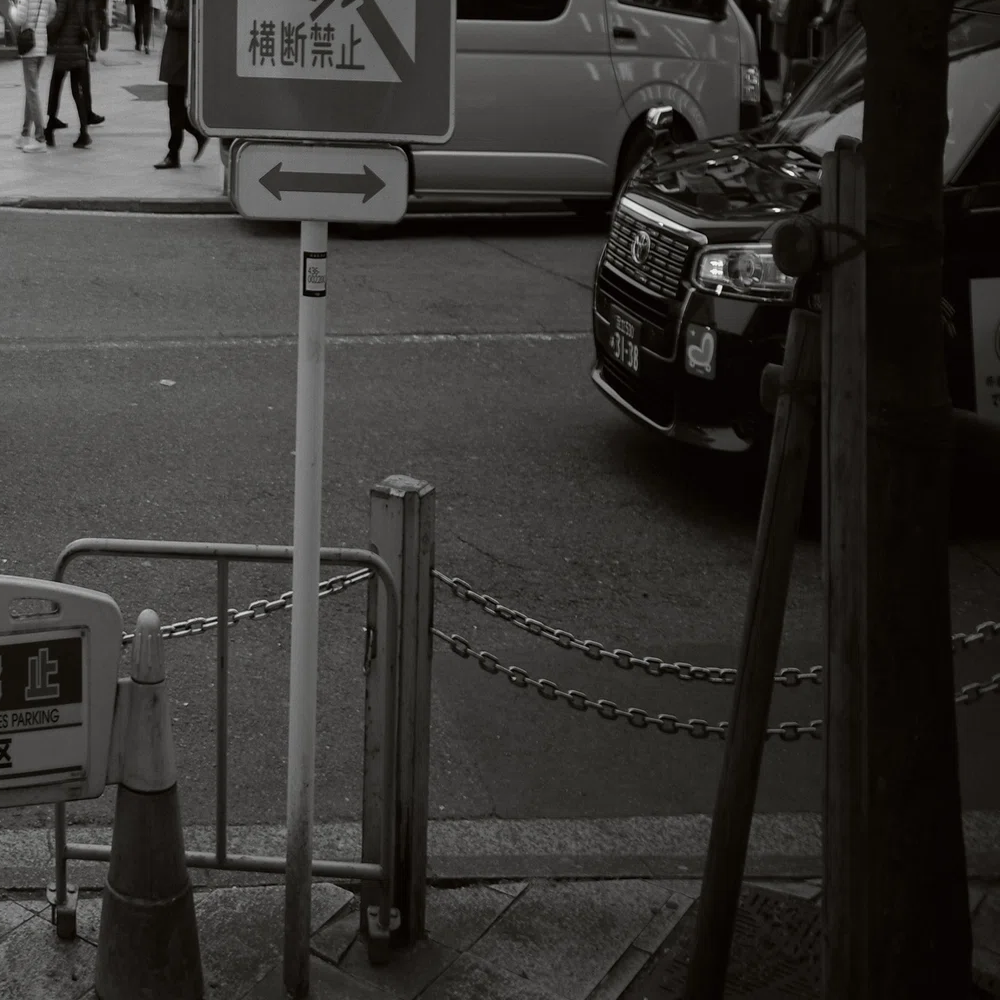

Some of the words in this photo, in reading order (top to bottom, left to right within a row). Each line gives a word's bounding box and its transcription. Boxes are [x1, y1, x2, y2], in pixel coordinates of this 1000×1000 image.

[248, 20, 366, 70] 横断禁止
[614, 331, 639, 372] 31-38
[11, 707, 60, 727] PARKING
